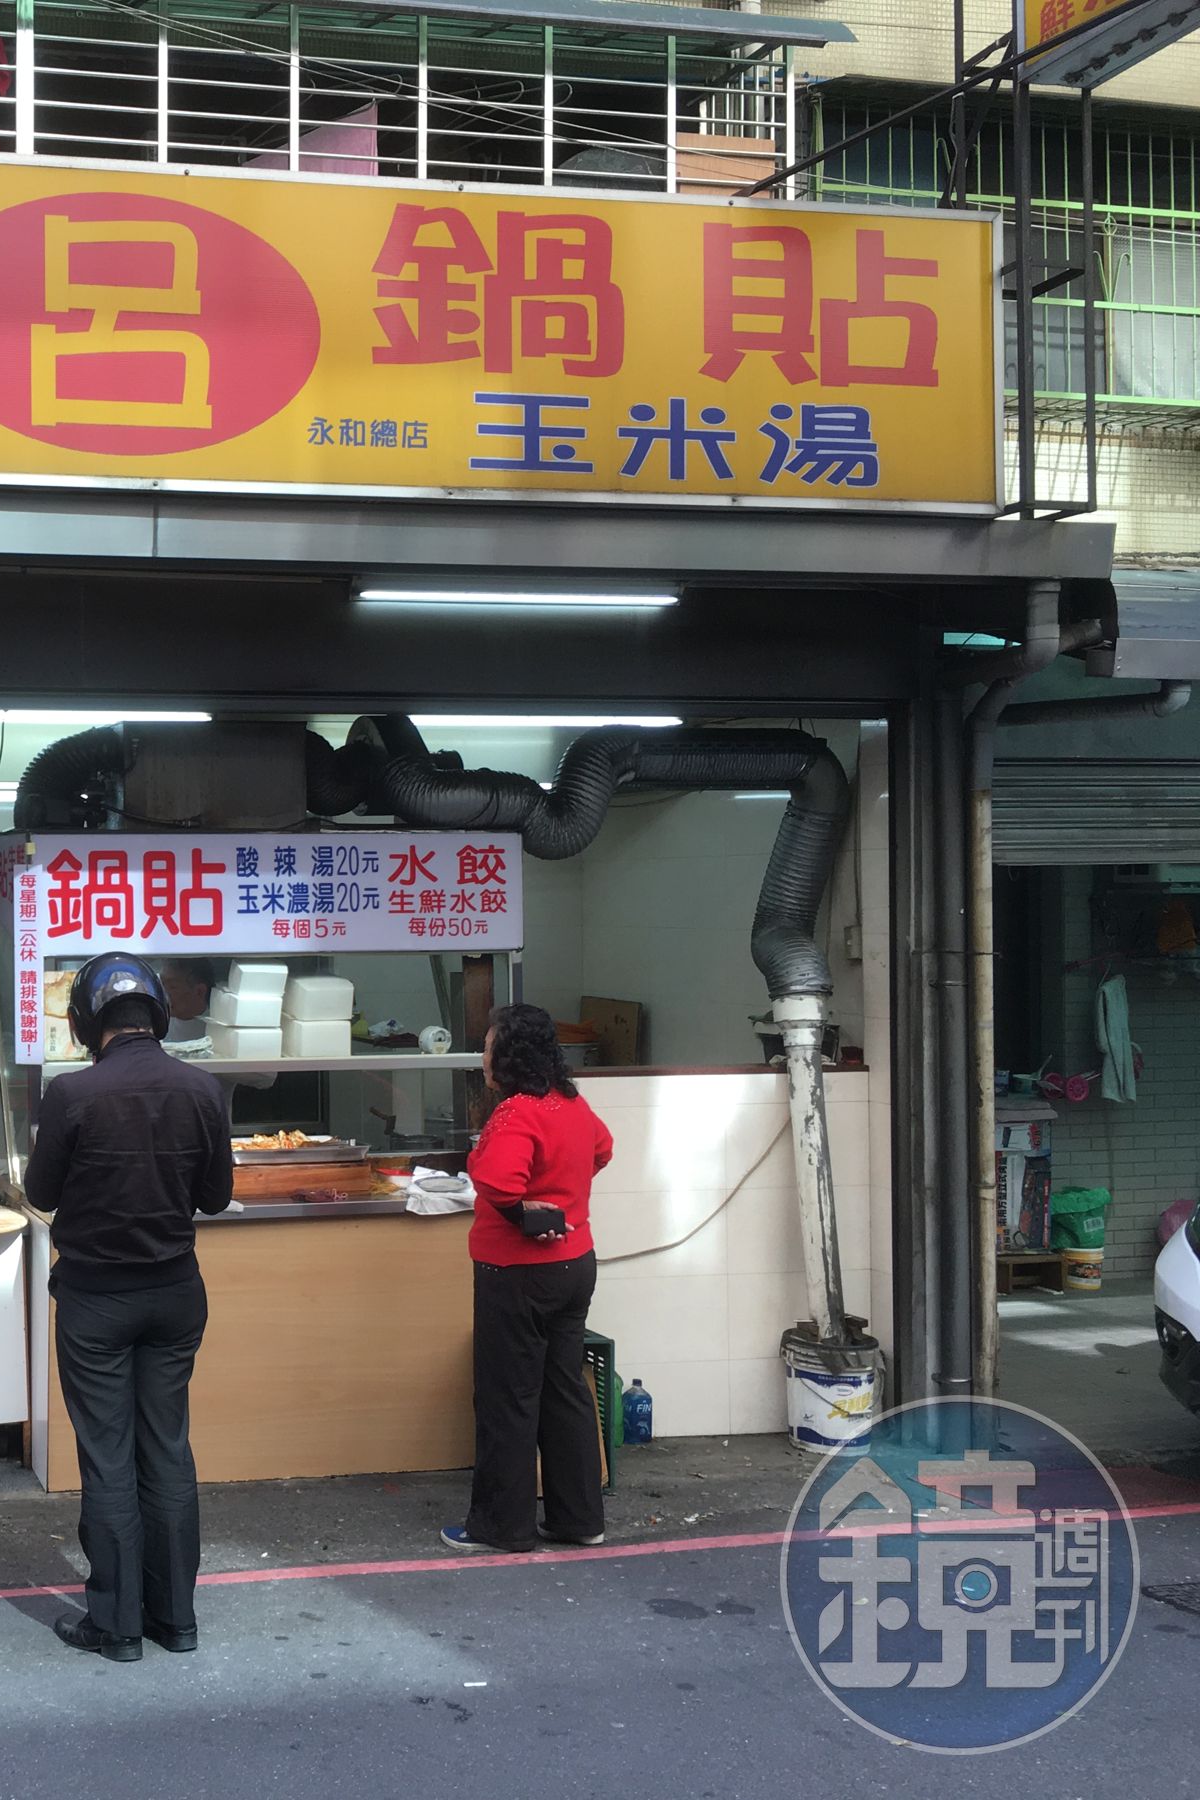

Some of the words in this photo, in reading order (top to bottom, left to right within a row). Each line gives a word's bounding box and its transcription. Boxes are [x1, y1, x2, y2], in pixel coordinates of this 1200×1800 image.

[371, 203, 940, 388] 鍋貼
[31, 214, 213, 429] 呂
[307, 415, 430, 450] 永和總店
[469, 391, 880, 488] 玉米湯
[236, 846, 380, 877] 酸辣湯20元
[388, 844, 507, 885] 水餃
[46, 848, 227, 940] 鍋貼
[237, 882, 381, 914] 玉米濃湯20元
[388, 889, 508, 914] 生鮮水餃
[19, 873, 38, 962] 每星期二公休
[272, 918, 347, 938] 每個5元
[408, 917, 489, 937] 每份50元
